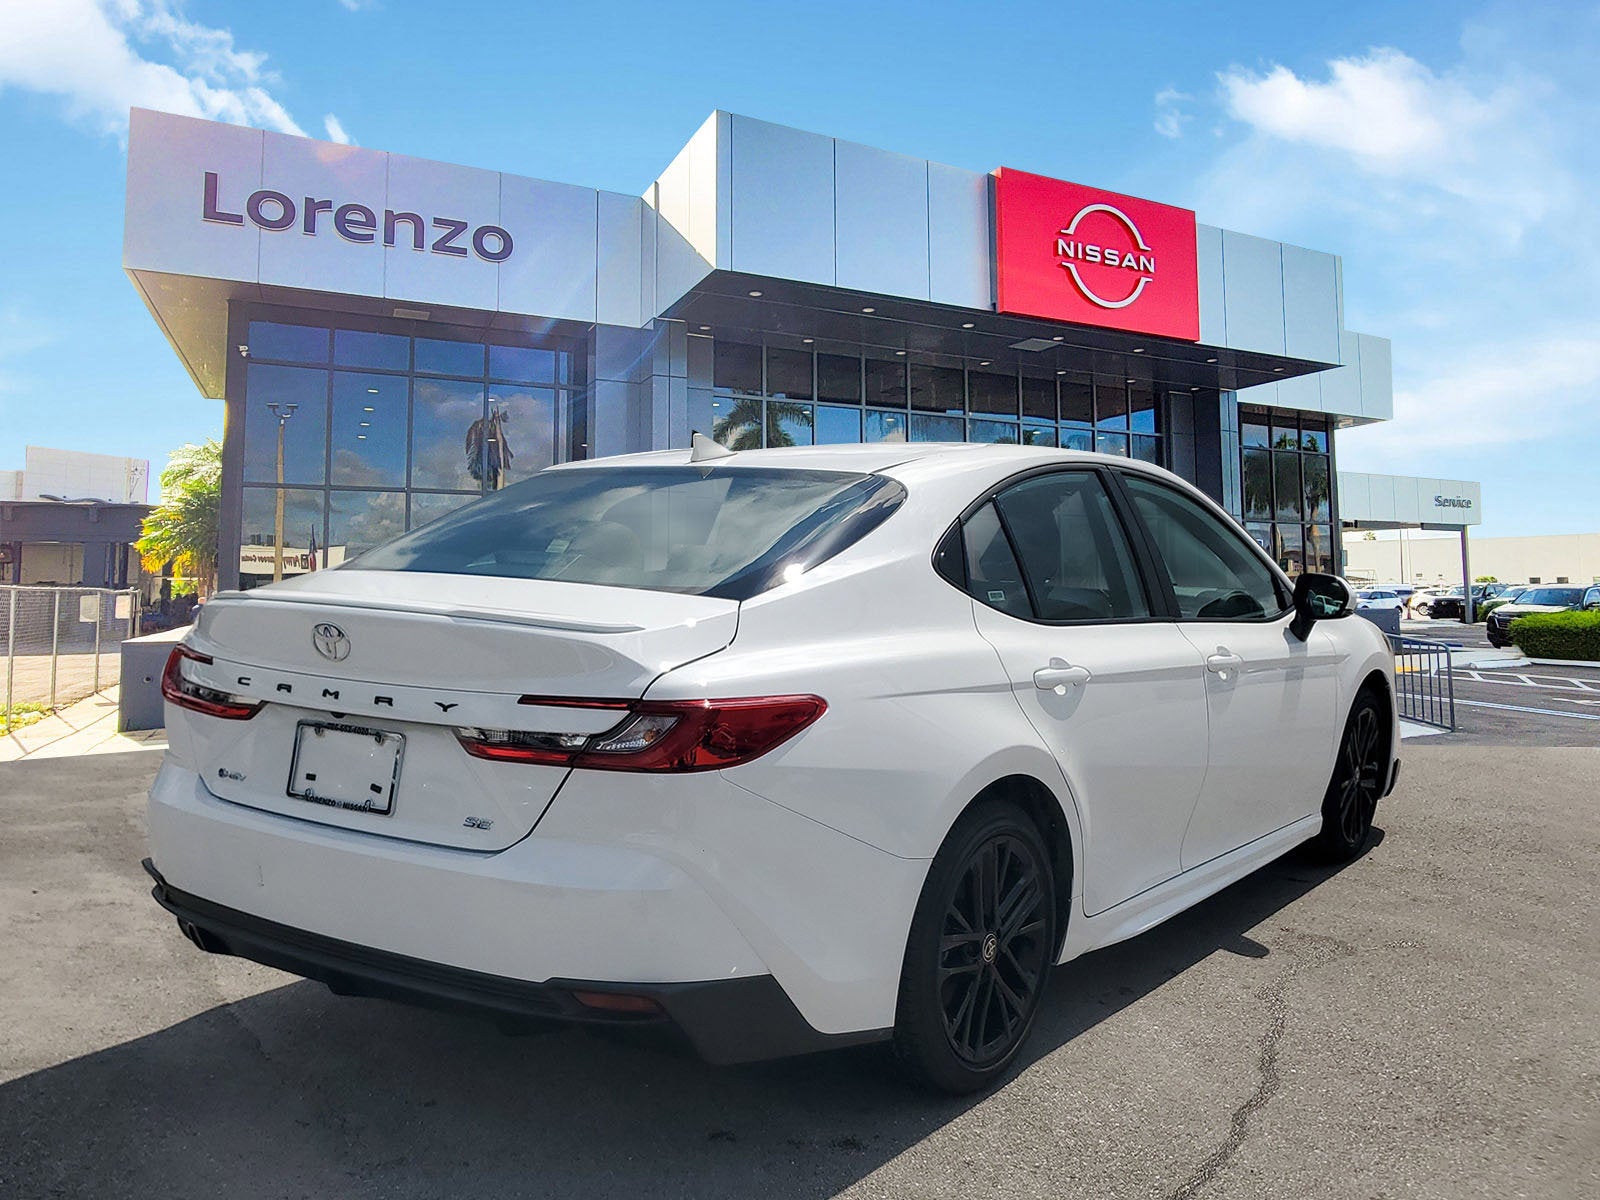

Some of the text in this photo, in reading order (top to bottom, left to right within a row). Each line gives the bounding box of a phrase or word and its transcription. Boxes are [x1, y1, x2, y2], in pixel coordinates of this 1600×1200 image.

[202, 170, 514, 262] Lorenzo
[1057, 238, 1155, 273] NISSAN
[1434, 495, 1472, 509] Service
[237, 676, 459, 713] CAMRY
[463, 816, 494, 831] SE
